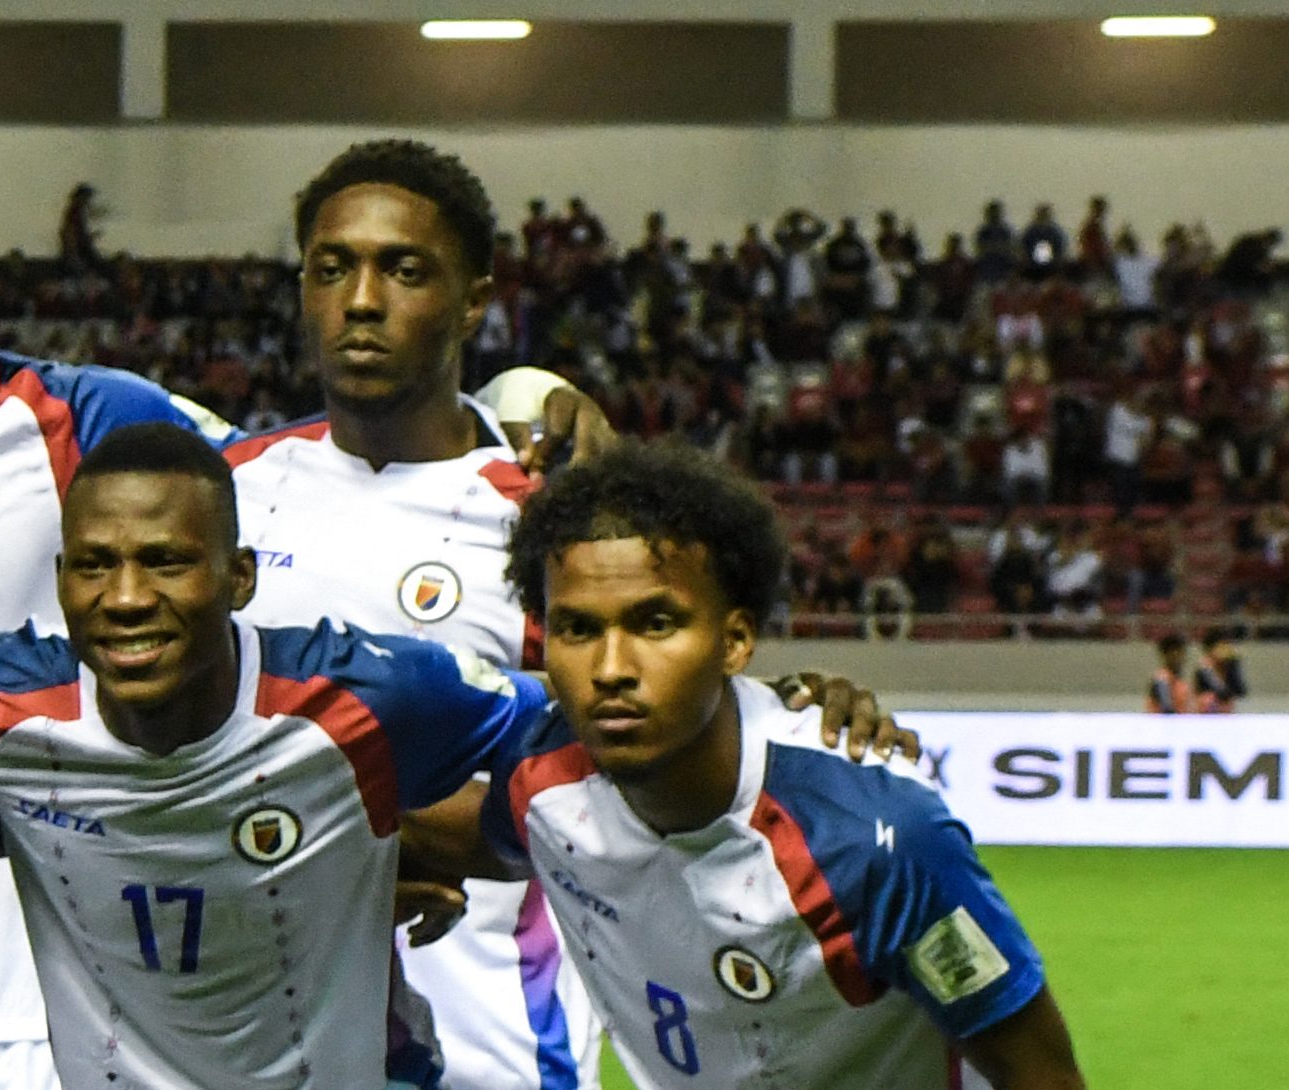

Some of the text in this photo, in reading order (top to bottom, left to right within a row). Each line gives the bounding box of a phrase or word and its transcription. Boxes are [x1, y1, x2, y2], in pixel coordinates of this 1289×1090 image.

[992, 747, 1282, 800] SIEM
[12, 800, 107, 837] SAETA
[122, 884, 204, 973] 17
[646, 980, 700, 1075] 8
